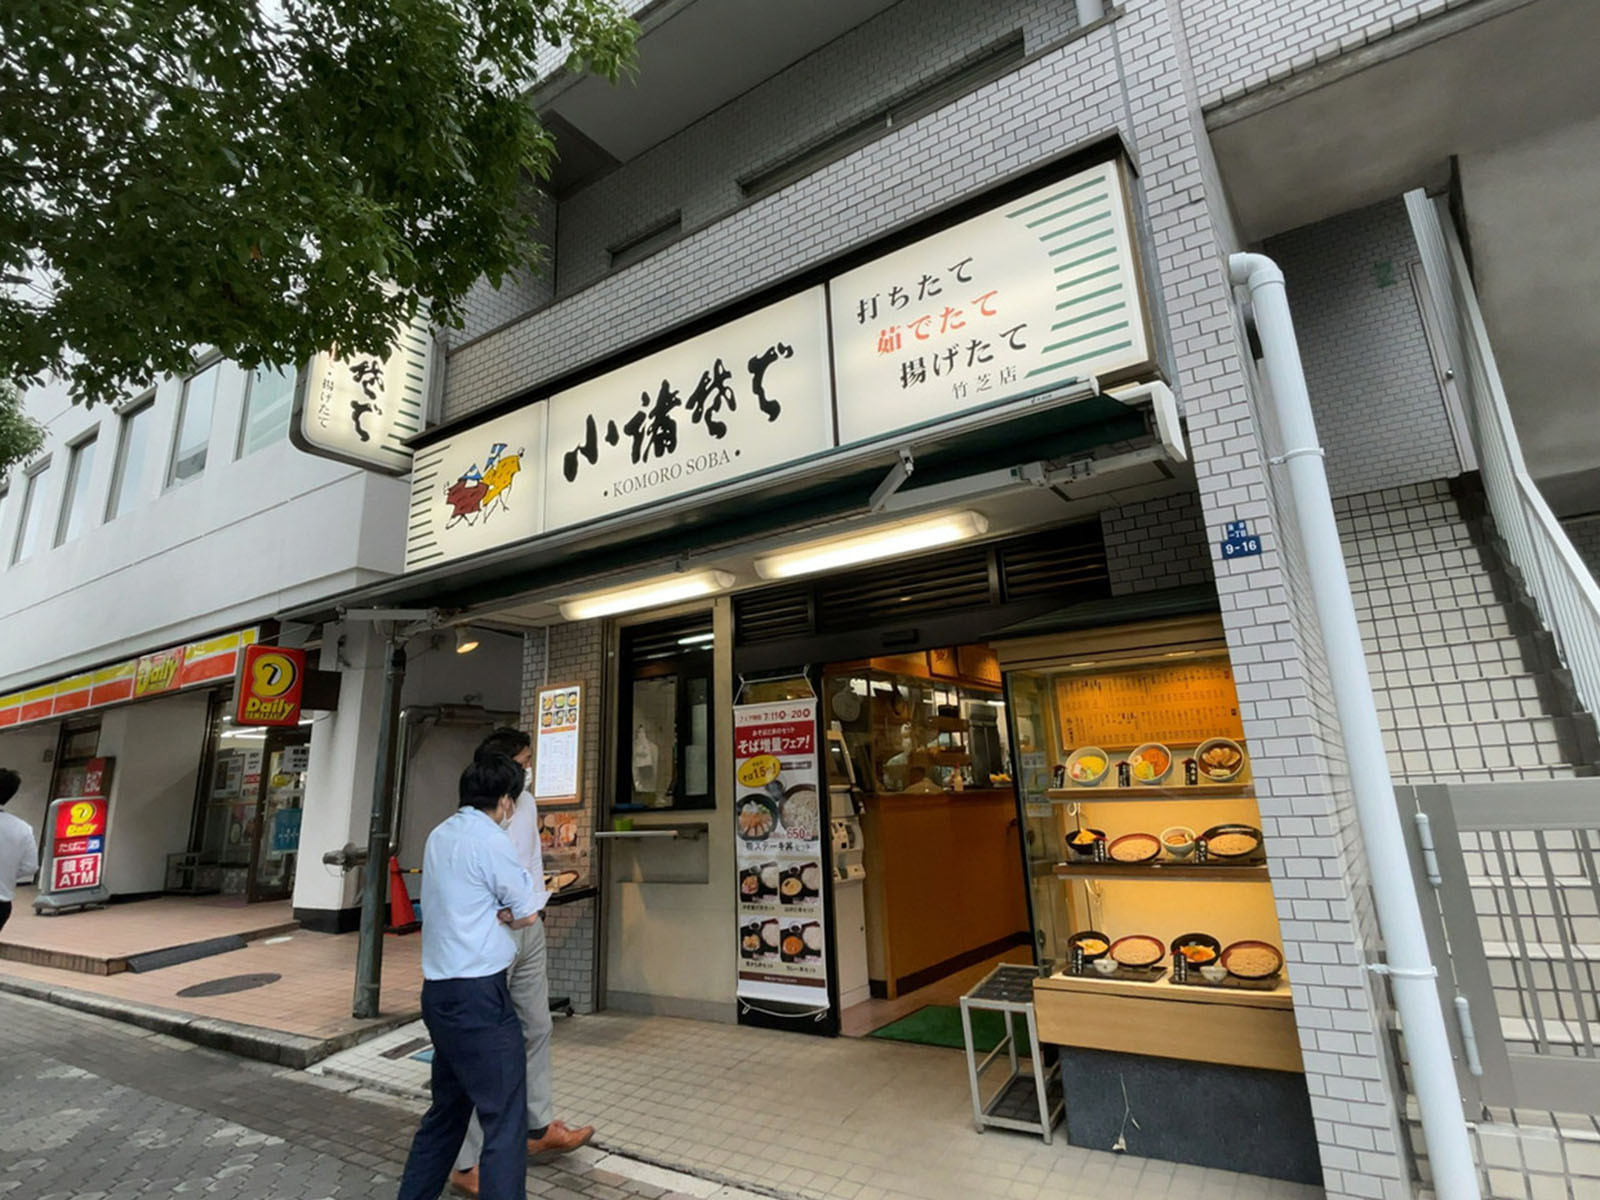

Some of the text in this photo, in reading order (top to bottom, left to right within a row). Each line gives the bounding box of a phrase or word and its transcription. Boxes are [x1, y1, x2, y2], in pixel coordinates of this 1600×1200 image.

[857, 257, 974, 324] 打ちたて
[877, 290, 999, 354] 茹でたて
[899, 323, 1028, 389] 揚げたて
[951, 365, 1018, 400] 竹芝店
[612, 449, 731, 498] KOMORO SOBA
[1225, 540, 1257, 555] 9-16
[245, 697, 297, 720] Daily
[59, 871, 94, 887] ATM
[62, 858, 94, 873] 銀行
